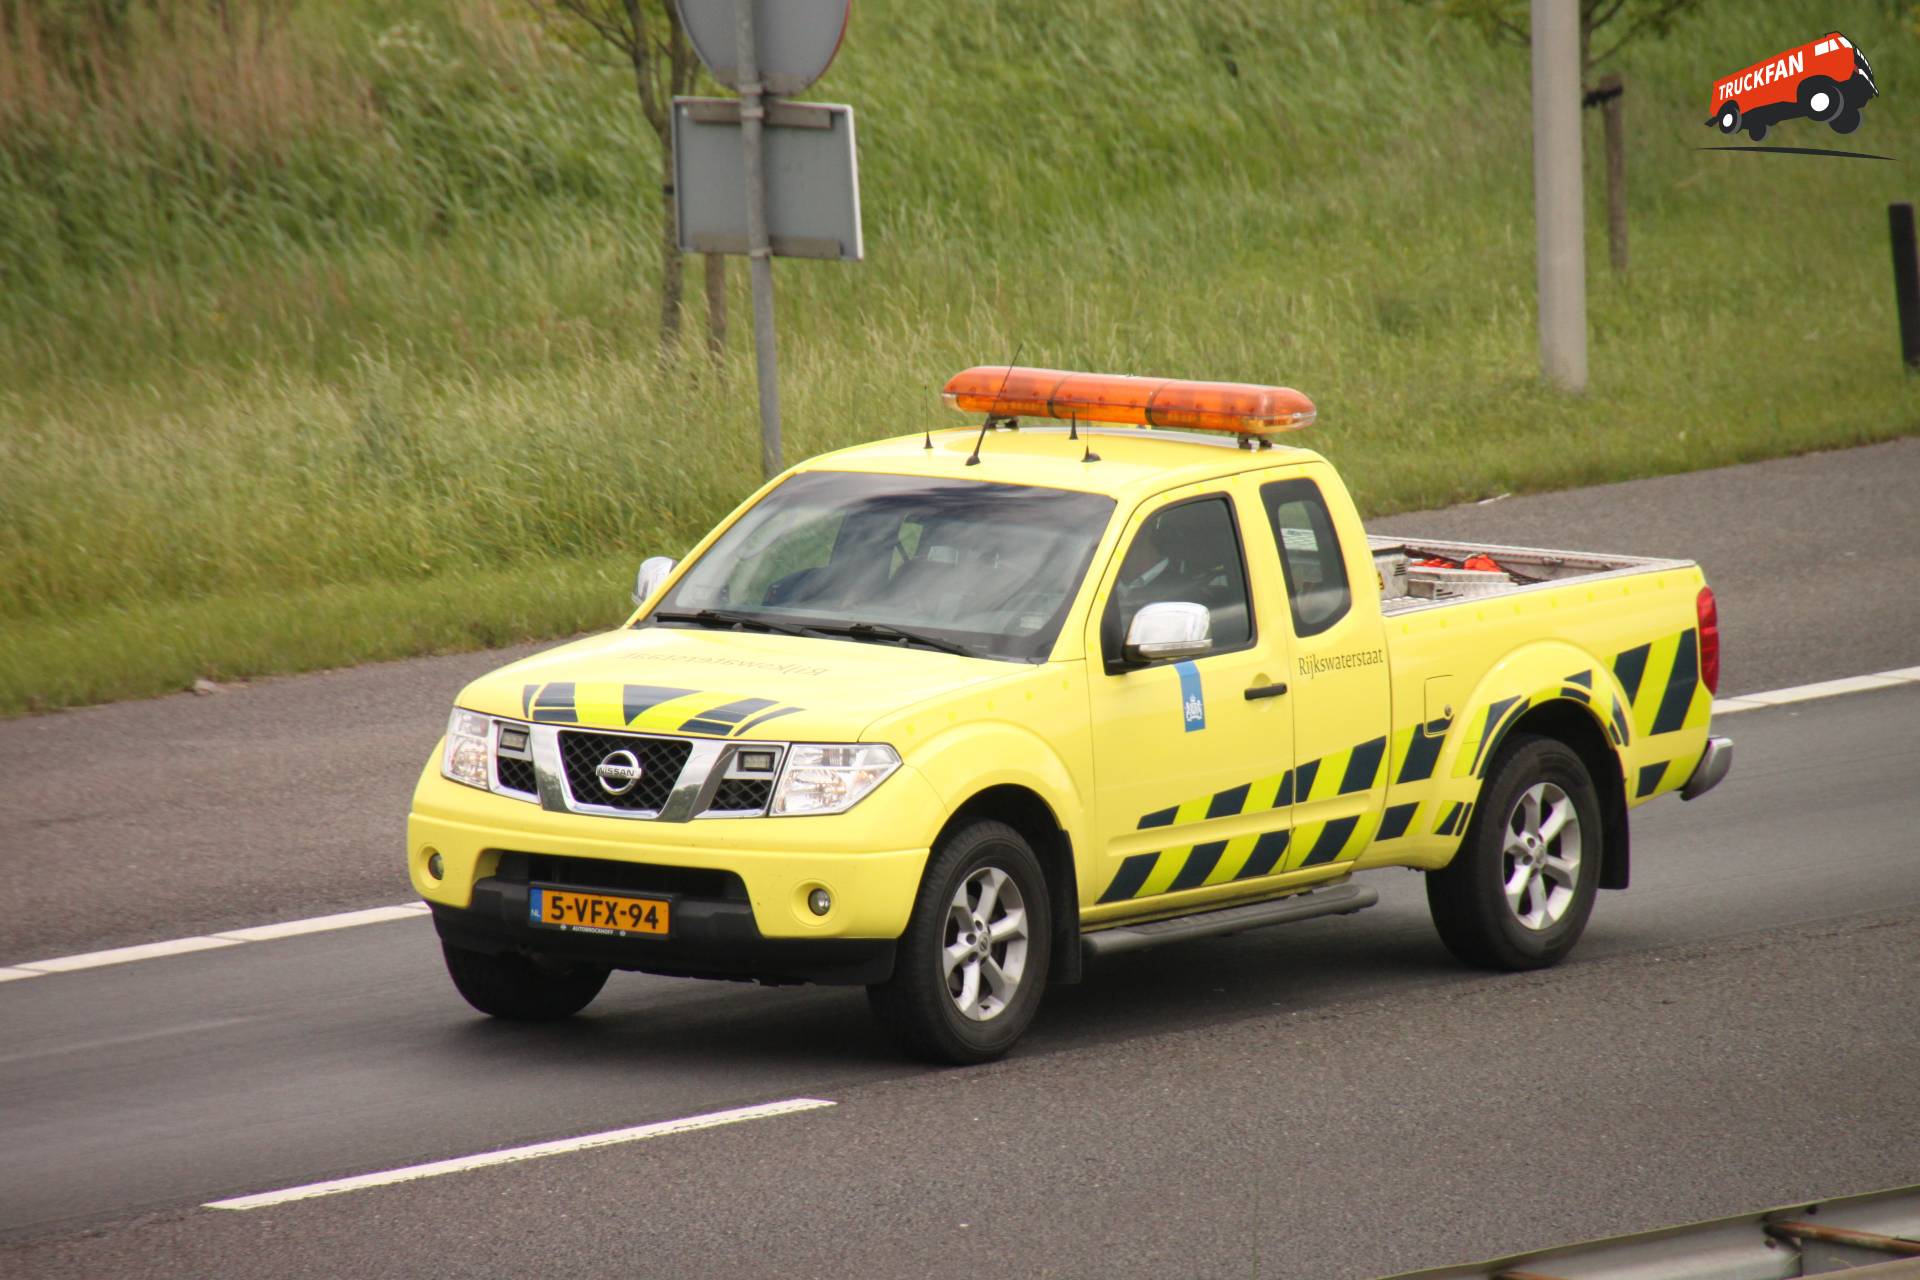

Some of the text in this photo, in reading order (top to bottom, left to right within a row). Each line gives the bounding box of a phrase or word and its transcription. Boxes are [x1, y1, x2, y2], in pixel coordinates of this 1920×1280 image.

[1298, 649, 1383, 679] Rijkswaterstaat
[598, 767, 635, 777] NISSAN
[530, 896, 658, 929] NL 5-VFX-94
